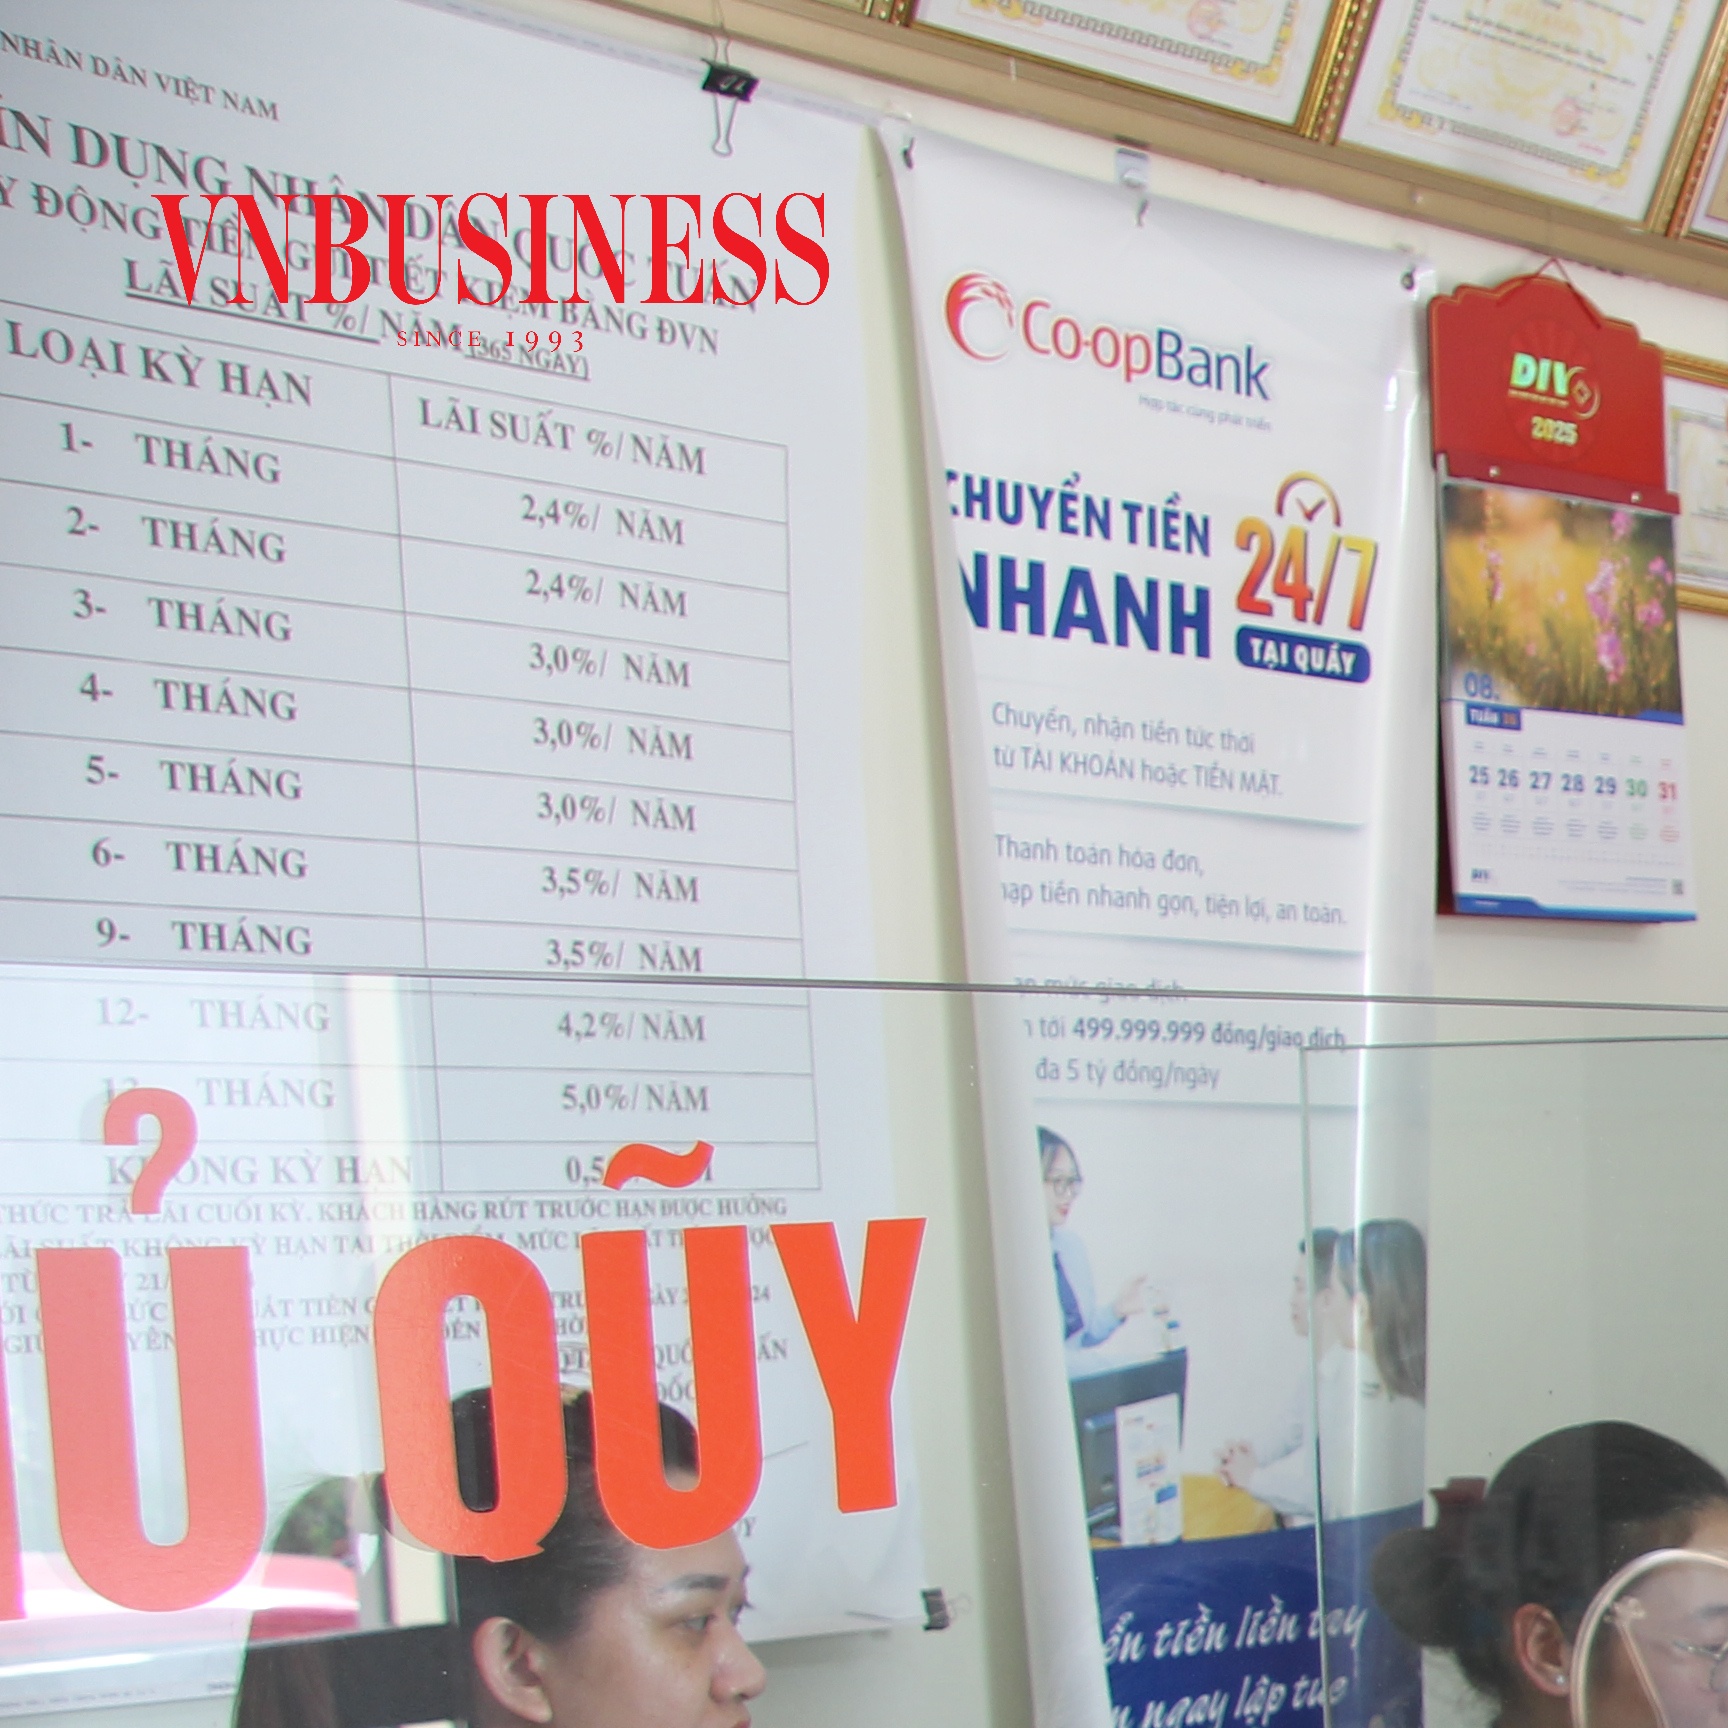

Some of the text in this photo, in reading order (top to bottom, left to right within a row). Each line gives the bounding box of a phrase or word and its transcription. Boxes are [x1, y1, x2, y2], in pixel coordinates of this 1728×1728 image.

[90, 55, 148, 88] DÂN
[155, 70, 216, 106] VIỆT
[222, 88, 280, 122] NAM
[67, 122, 231, 198] DỤNG
[31, 184, 719, 357] ĐỘNG BẰNG ĐVN
[5, 319, 313, 408] LOẠI KỲ HẠN
[418, 396, 482, 436] LÃI
[489, 409, 576, 451] SUẤT
[631, 432, 708, 476] NĂM
[1531, 415, 1580, 446] 2025
[60, 421, 282, 484] 1- THÁNG
[67, 505, 287, 564] 2- THÁNG
[615, 505, 686, 546] NĂM
[1122, 490, 1211, 558] TIỀN
[1234, 515, 1378, 632] 24/7
[72, 588, 293, 643] 3- THÁNG
[618, 579, 689, 618] NĂM
[958, 549, 1211, 660] NHANH
[622, 651, 692, 689] NĂM
[1249, 637, 1289, 669] TẠI
[79, 671, 298, 722] 4- THÁNG
[626, 724, 695, 761] NĂM
[1083, 712, 1135, 742] nhận
[85, 754, 304, 800] 5- THÁNG
[1020, 744, 1052, 772] TÀI
[1059, 750, 1135, 780] KHOẢN
[1140, 758, 1189, 788] hoặc
[1192, 760, 1235, 791] TIỀN
[1468, 764, 1678, 801] 25 26 27 28 29 30 31
[630, 797, 697, 832] NĂM
[91, 836, 309, 880] 6- THÁNG
[993, 832, 1058, 864] Thanh
[1065, 840, 1112, 867] toán
[1117, 842, 1156, 870] hóa
[634, 869, 700, 903] NĂM
[1086, 882, 1151, 911] nhanh
[1205, 893, 1240, 919] tiện
[1274, 900, 1297, 923] an
[96, 915, 314, 957] 9- THÁNG
[638, 941, 703, 973] NĂM
[641, 1009, 708, 1042] NĂM
[1071, 1016, 1205, 1043] 499.999.999
[1066, 1056, 1080, 1081] 5
[645, 1081, 711, 1113] NĂM
[271, 1148, 323, 1186] KỲ
[0, 1087, 267, 1620] Ủ
[1153, 1601, 1229, 1660] tiền
[1234, 1593, 1300, 1650] liền
[1233, 1674, 1288, 1727] lập
